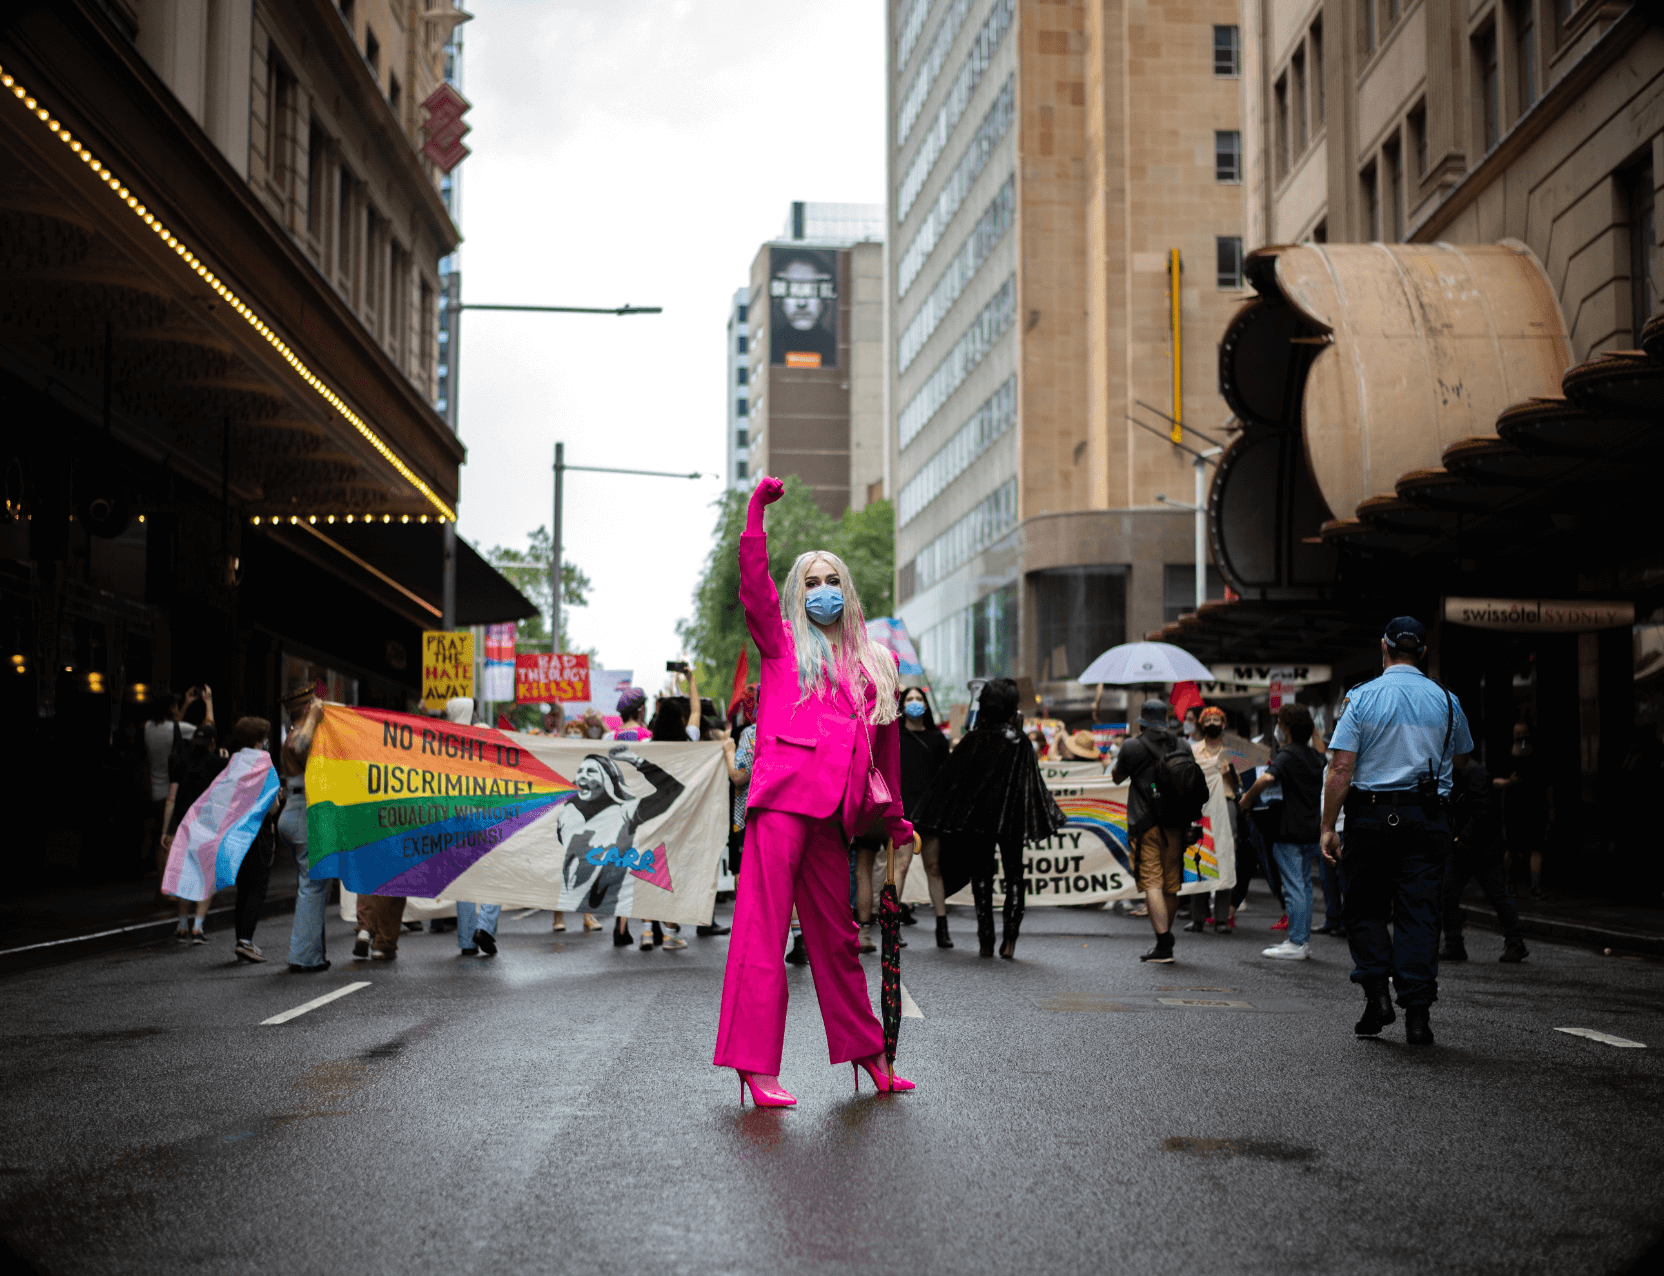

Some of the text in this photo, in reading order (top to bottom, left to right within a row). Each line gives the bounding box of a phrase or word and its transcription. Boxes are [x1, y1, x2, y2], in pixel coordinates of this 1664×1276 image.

[1545, 608, 1617, 624] SYDNEY
[427, 635, 468, 651] PRAY
[433, 650, 463, 664] THE
[538, 655, 577, 669] BAD
[426, 664, 472, 679] HATE
[518, 668, 587, 682] THEOLOGY
[1233, 667, 1309, 680] MYR
[425, 684, 469, 700] AWAY
[383, 720, 520, 768] NO RIGHT TO
[368, 763, 533, 800] DISCRIMINATE!
[378, 804, 521, 828] EQUALITY WITHOUT
[402, 828, 503, 858] EXEMPTIONS!
